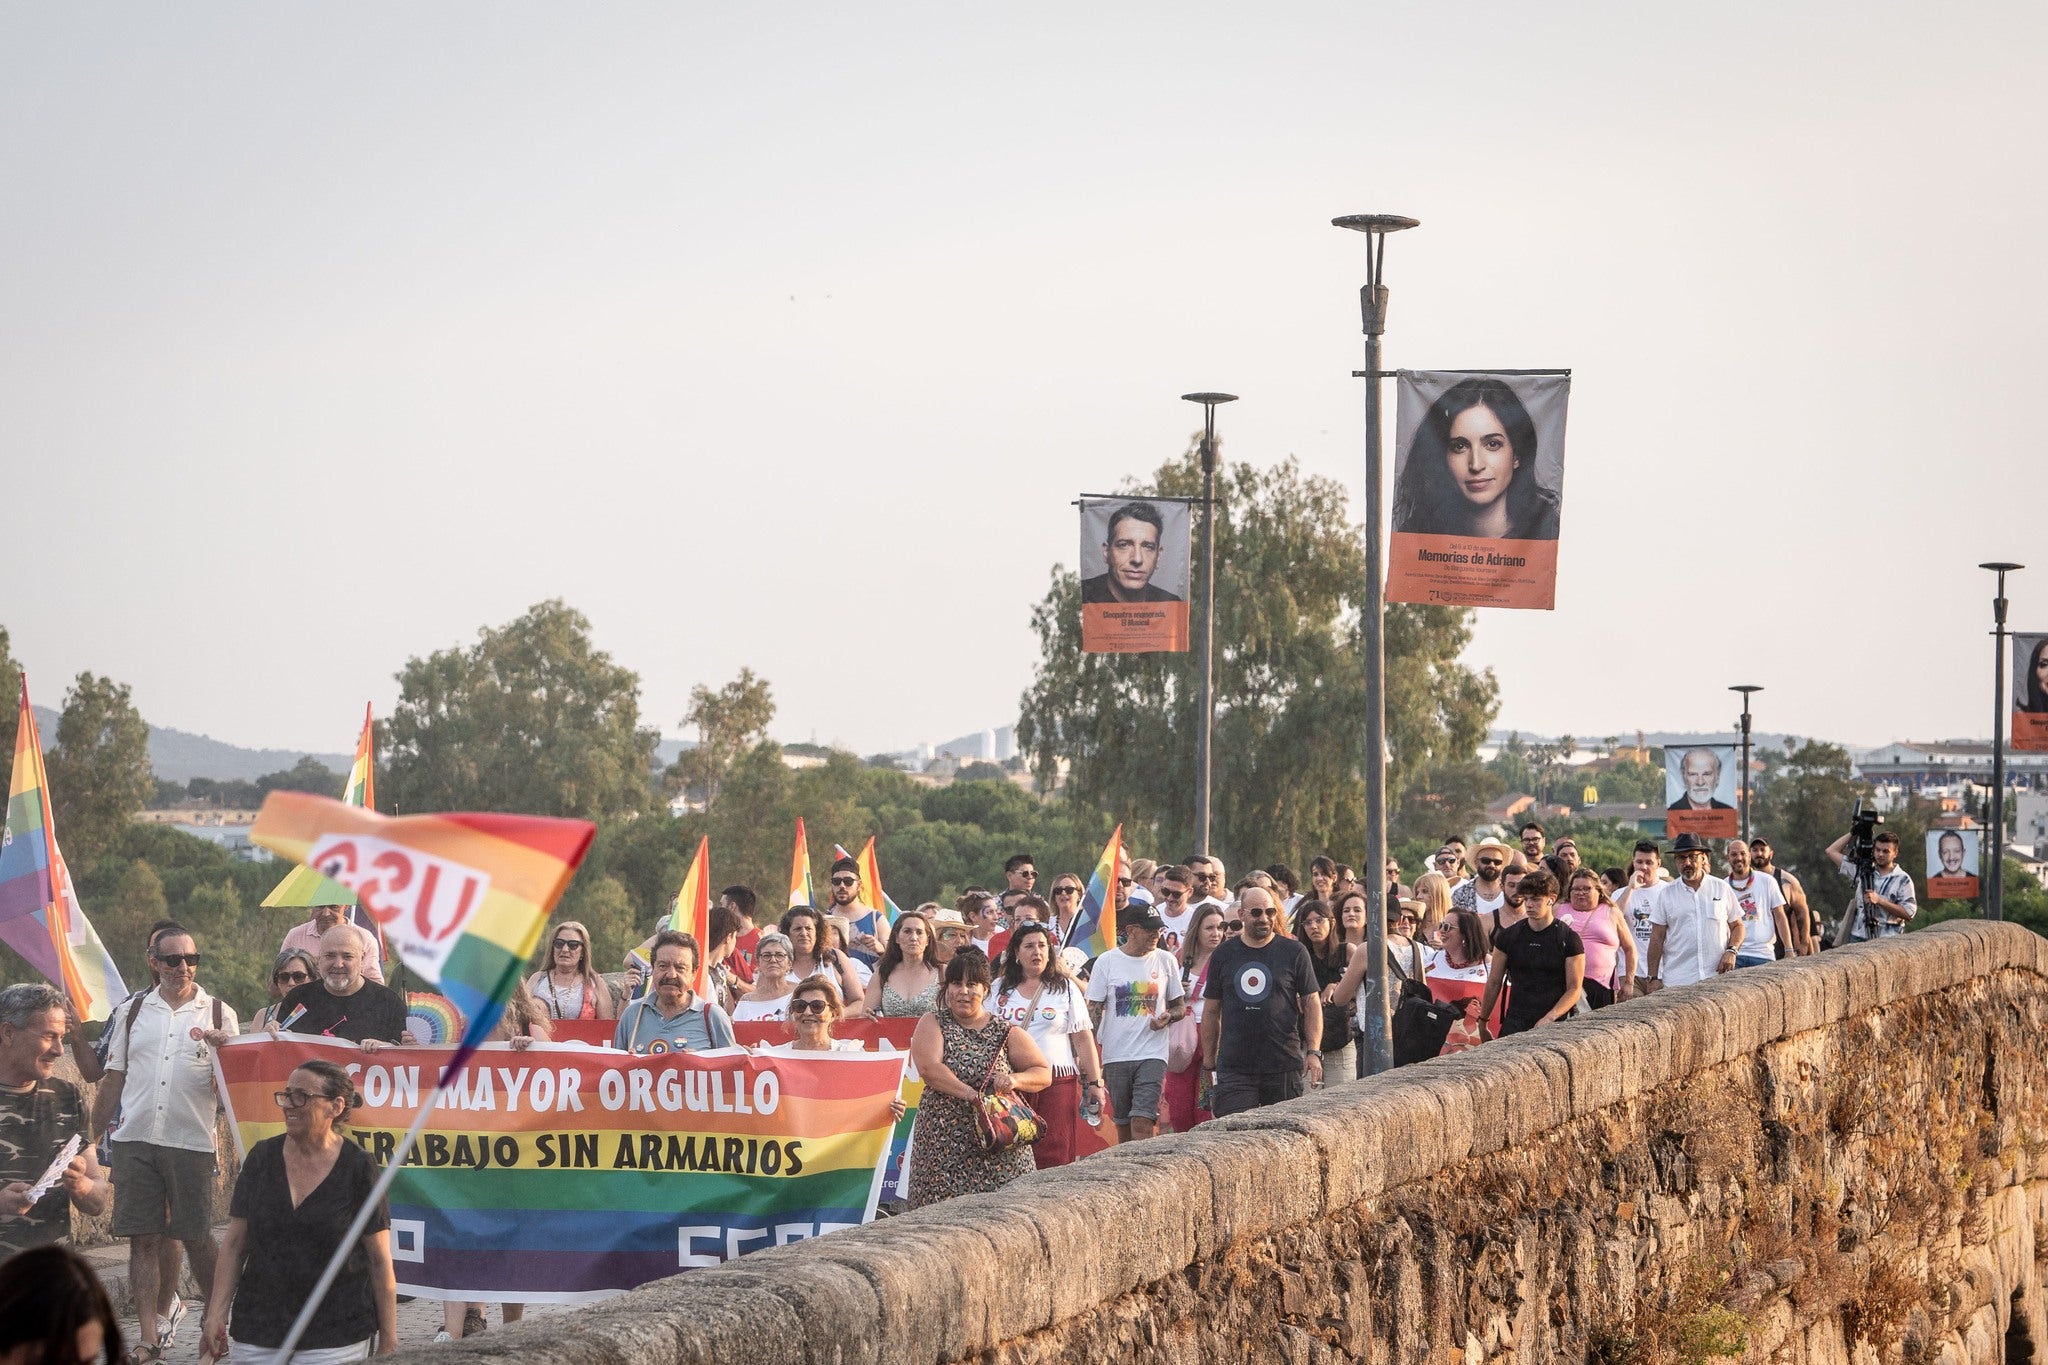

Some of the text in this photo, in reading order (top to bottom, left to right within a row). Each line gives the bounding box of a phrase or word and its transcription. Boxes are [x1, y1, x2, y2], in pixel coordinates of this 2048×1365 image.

[1418, 549, 1526, 568] Memorias de Adriano
[435, 1065, 584, 1113] MAYOR
[598, 1067, 780, 1116] ORGULLO
[352, 1130, 803, 1177] TRABAJO SIN ARMARIOS
